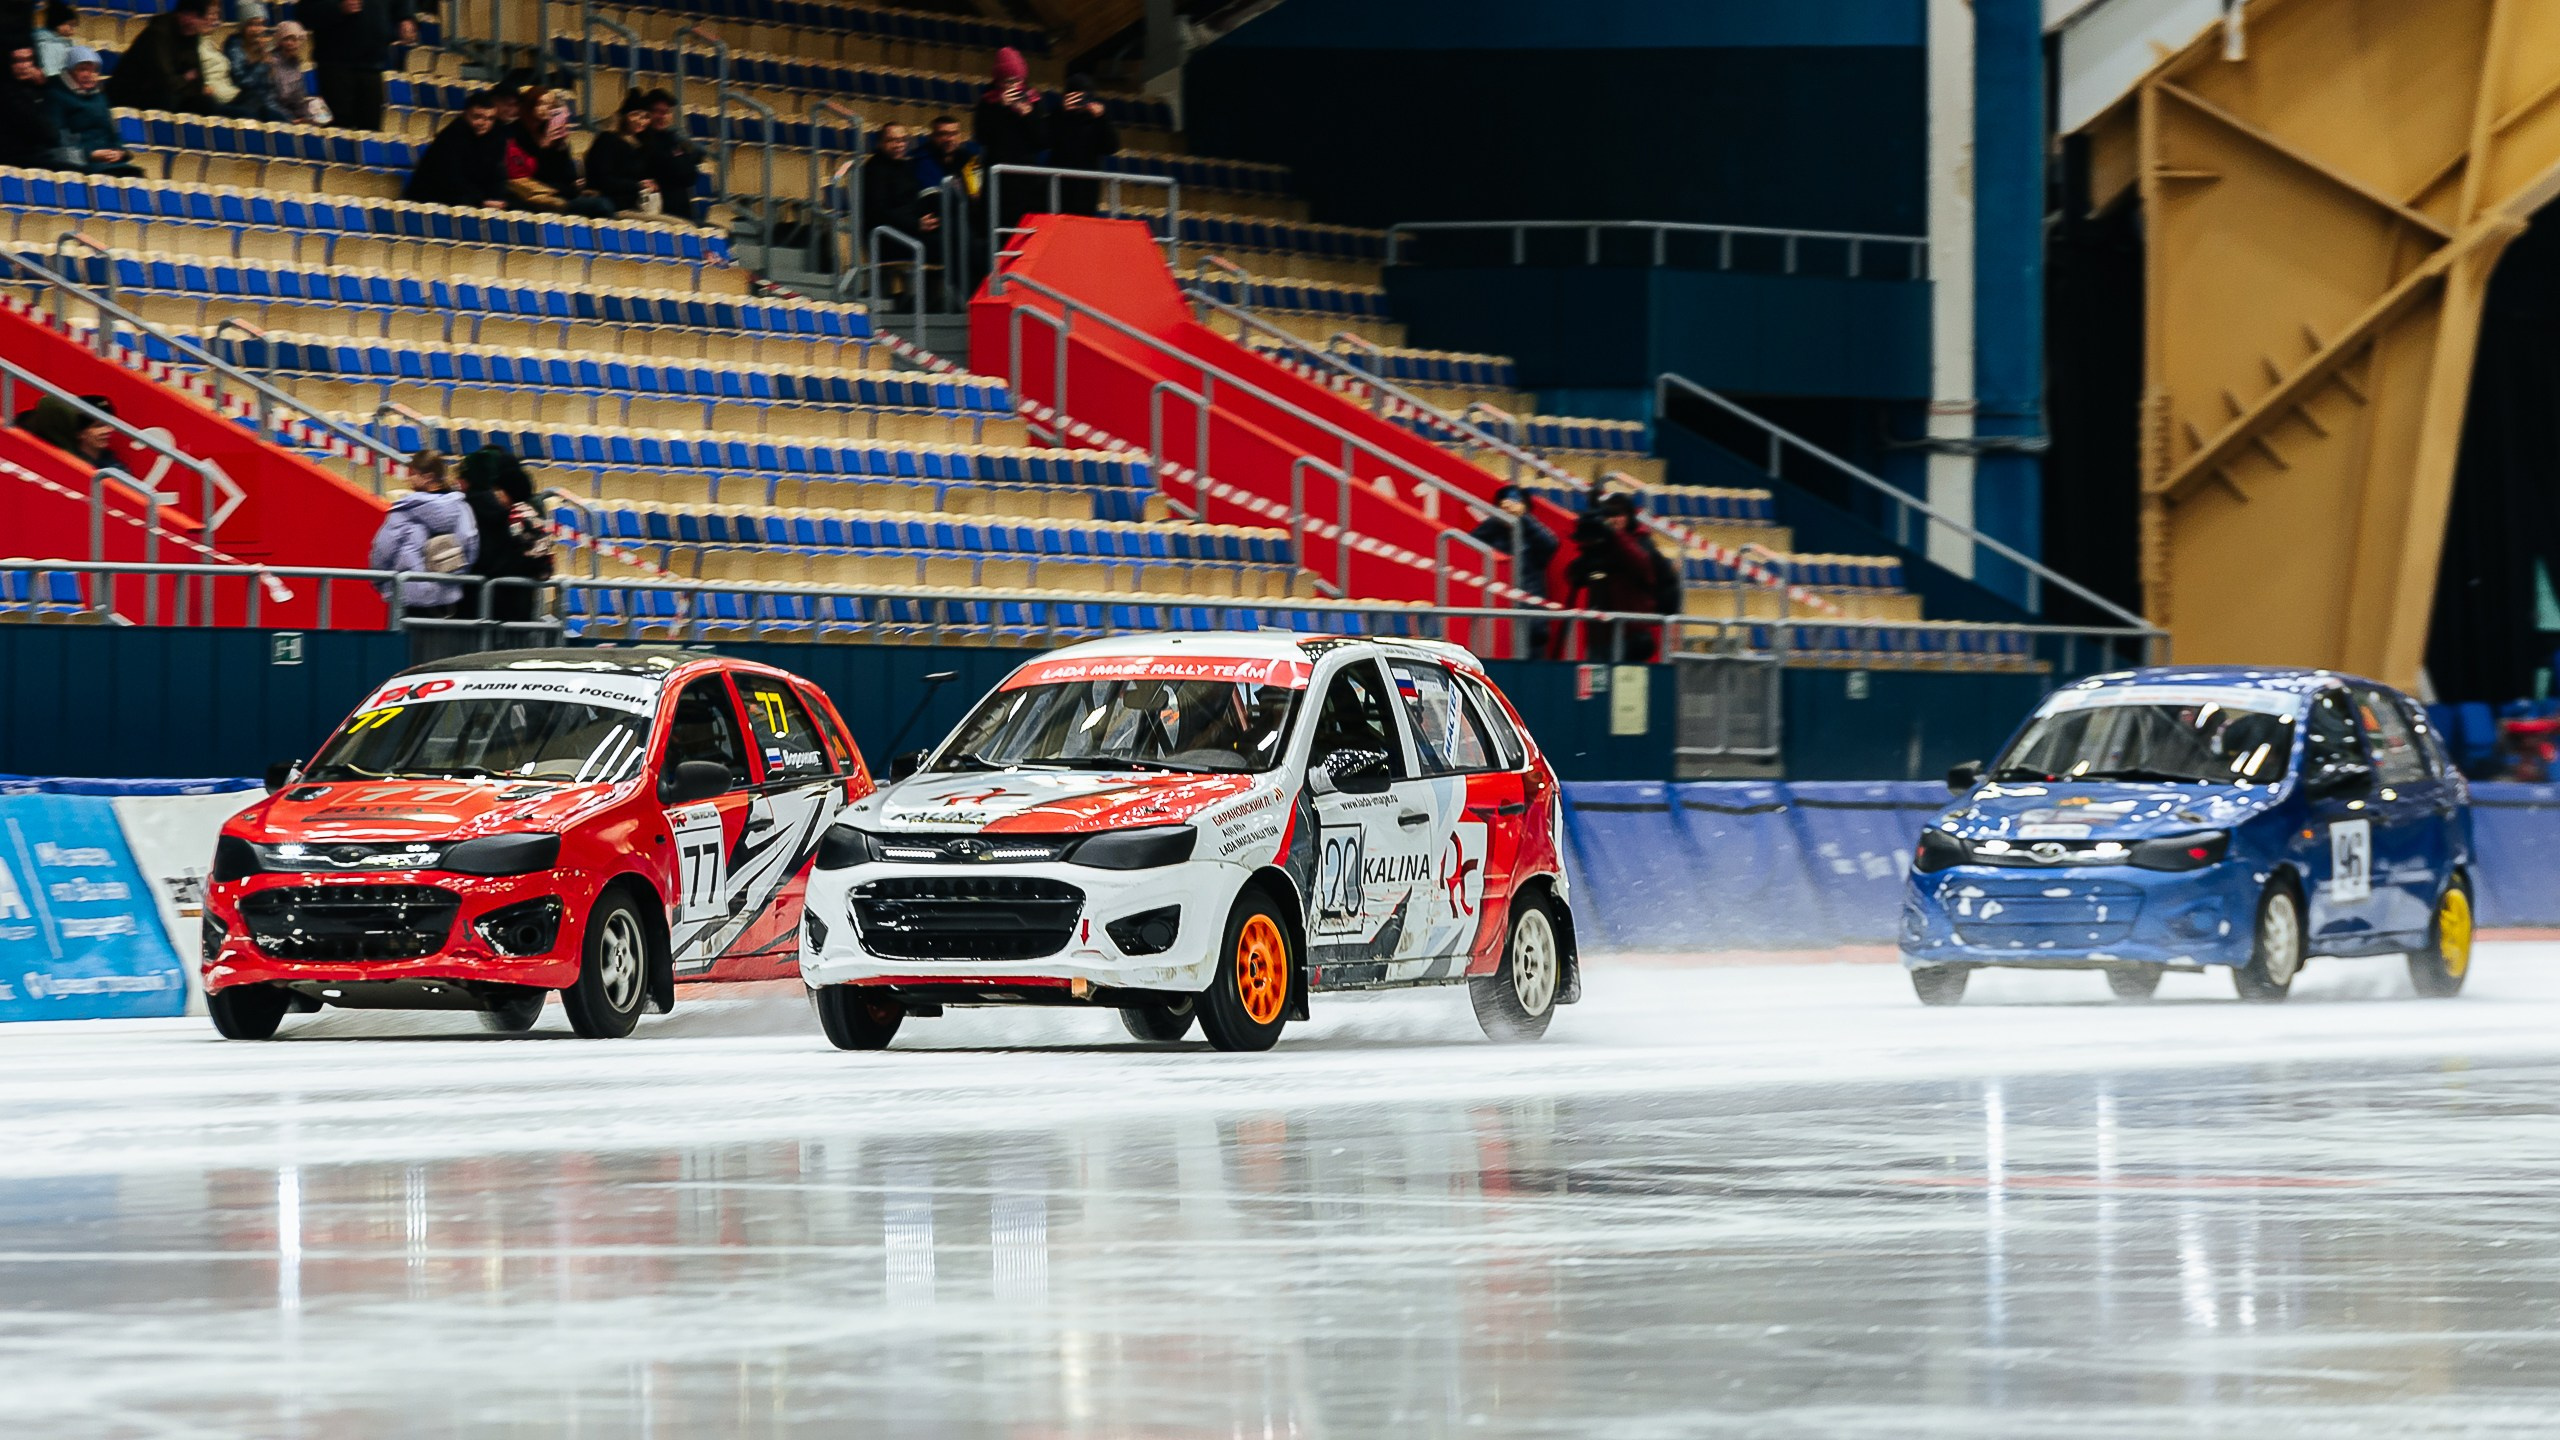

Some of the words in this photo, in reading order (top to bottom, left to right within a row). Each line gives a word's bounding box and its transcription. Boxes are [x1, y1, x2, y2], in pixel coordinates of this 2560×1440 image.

[1040, 665, 1087, 680] LADA
[1150, 664, 1210, 676] RALLY
[1212, 662, 1267, 679] TEAM
[462, 682, 519, 692] РАЛЛИ
[578, 686, 649, 707] РОССИИ
[347, 706, 405, 735] 77
[754, 691, 790, 734] 77
[355, 786, 472, 802] 77
[1339, 793, 1399, 811] www.lada-image.ru
[1218, 840, 1239, 857] LADA
[683, 842, 720, 907] 77
[1362, 853, 1431, 885] KALINA
